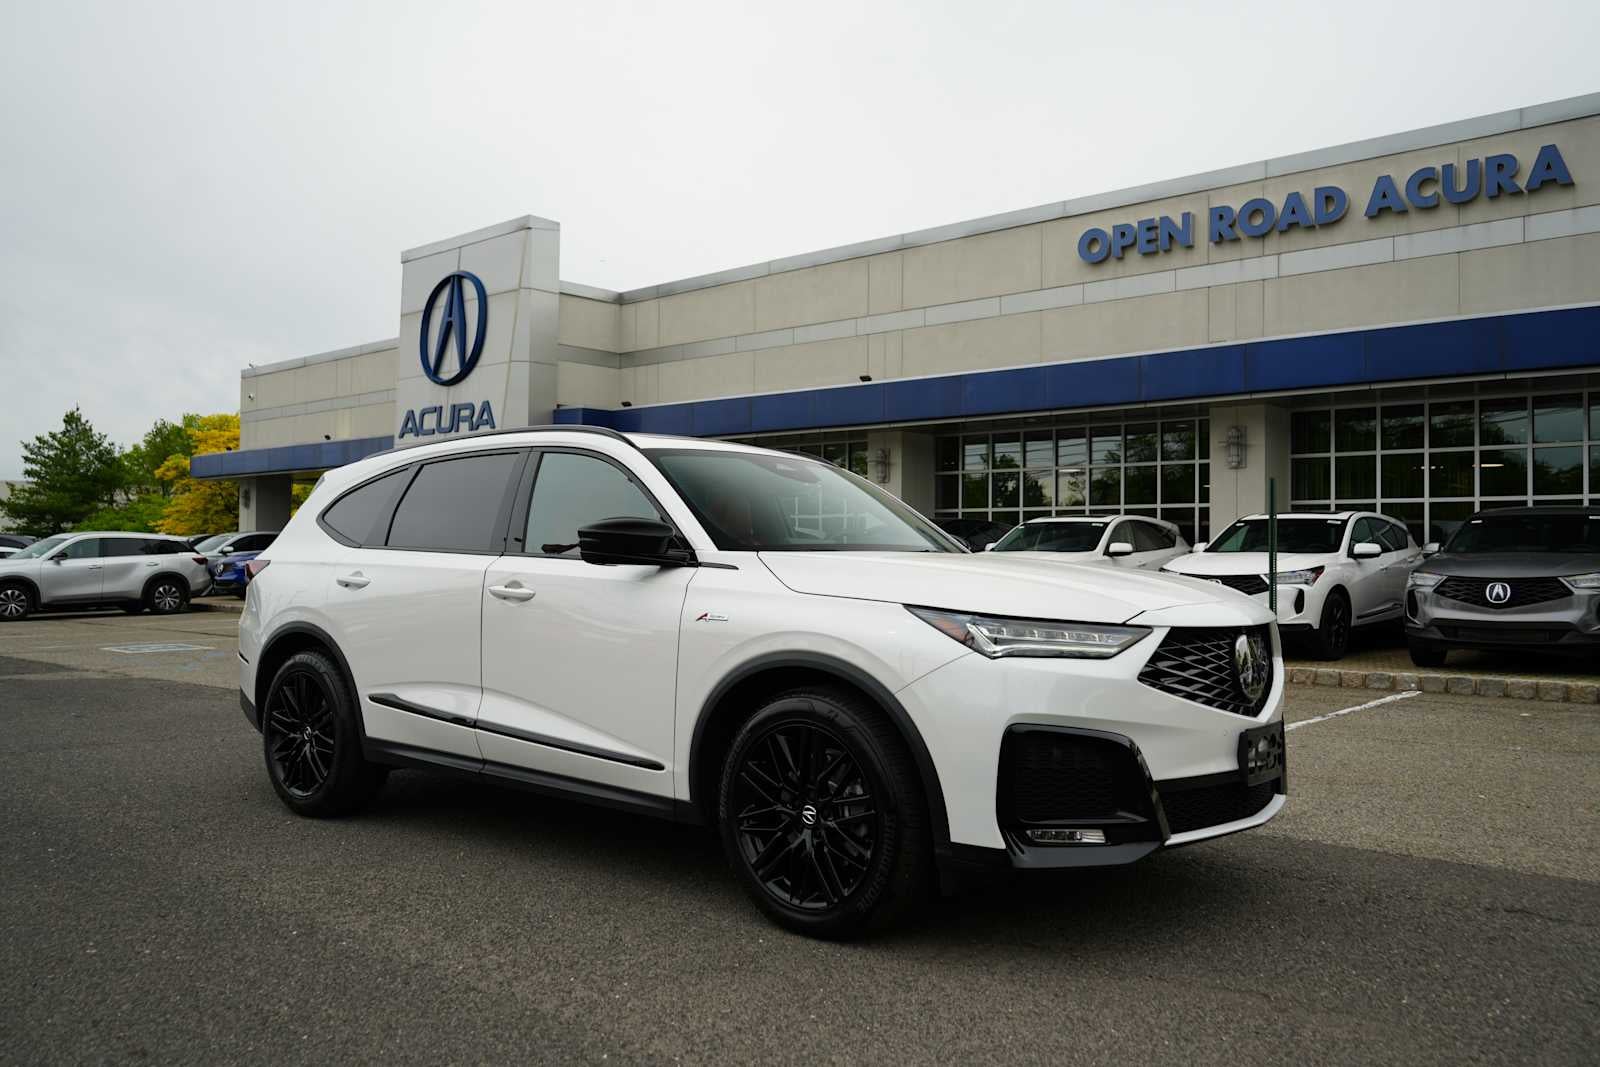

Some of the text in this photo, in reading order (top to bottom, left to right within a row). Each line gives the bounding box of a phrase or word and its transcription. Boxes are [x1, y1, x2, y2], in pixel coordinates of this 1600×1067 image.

[1078, 144, 1575, 264] OPEN ROAD ACURA
[399, 400, 496, 439] ACURA
